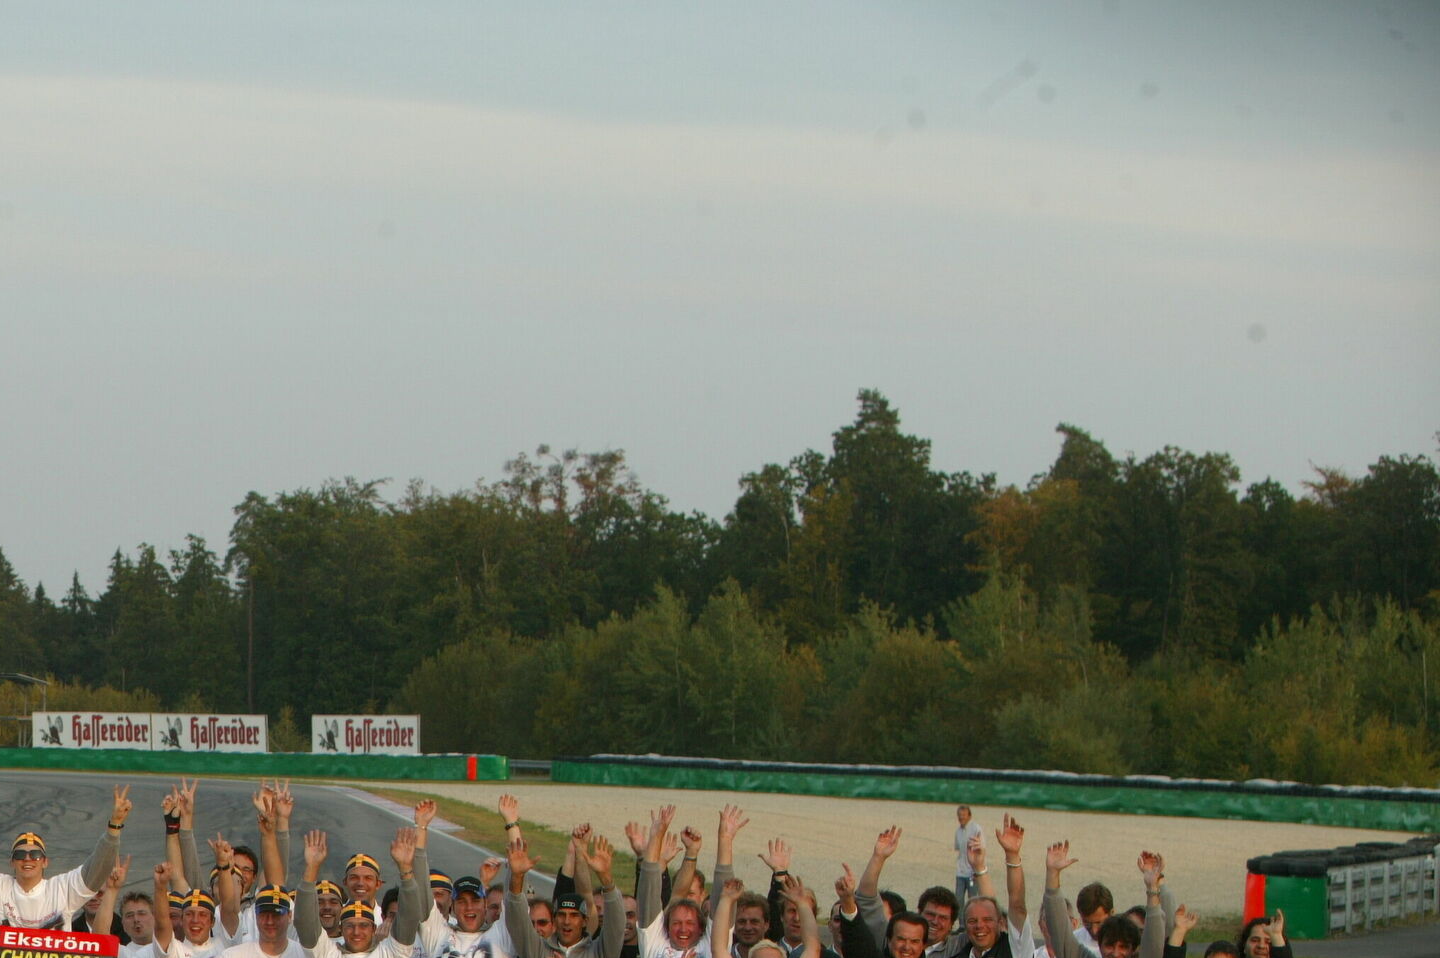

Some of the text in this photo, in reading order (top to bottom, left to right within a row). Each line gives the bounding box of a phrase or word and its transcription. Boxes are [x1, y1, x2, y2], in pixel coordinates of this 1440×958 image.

[72, 714, 148, 747] Hasseröder
[190, 716, 260, 749] Hasseröder
[345, 718, 414, 753] Hasseröder
[3, 931, 100, 952] Ekström
